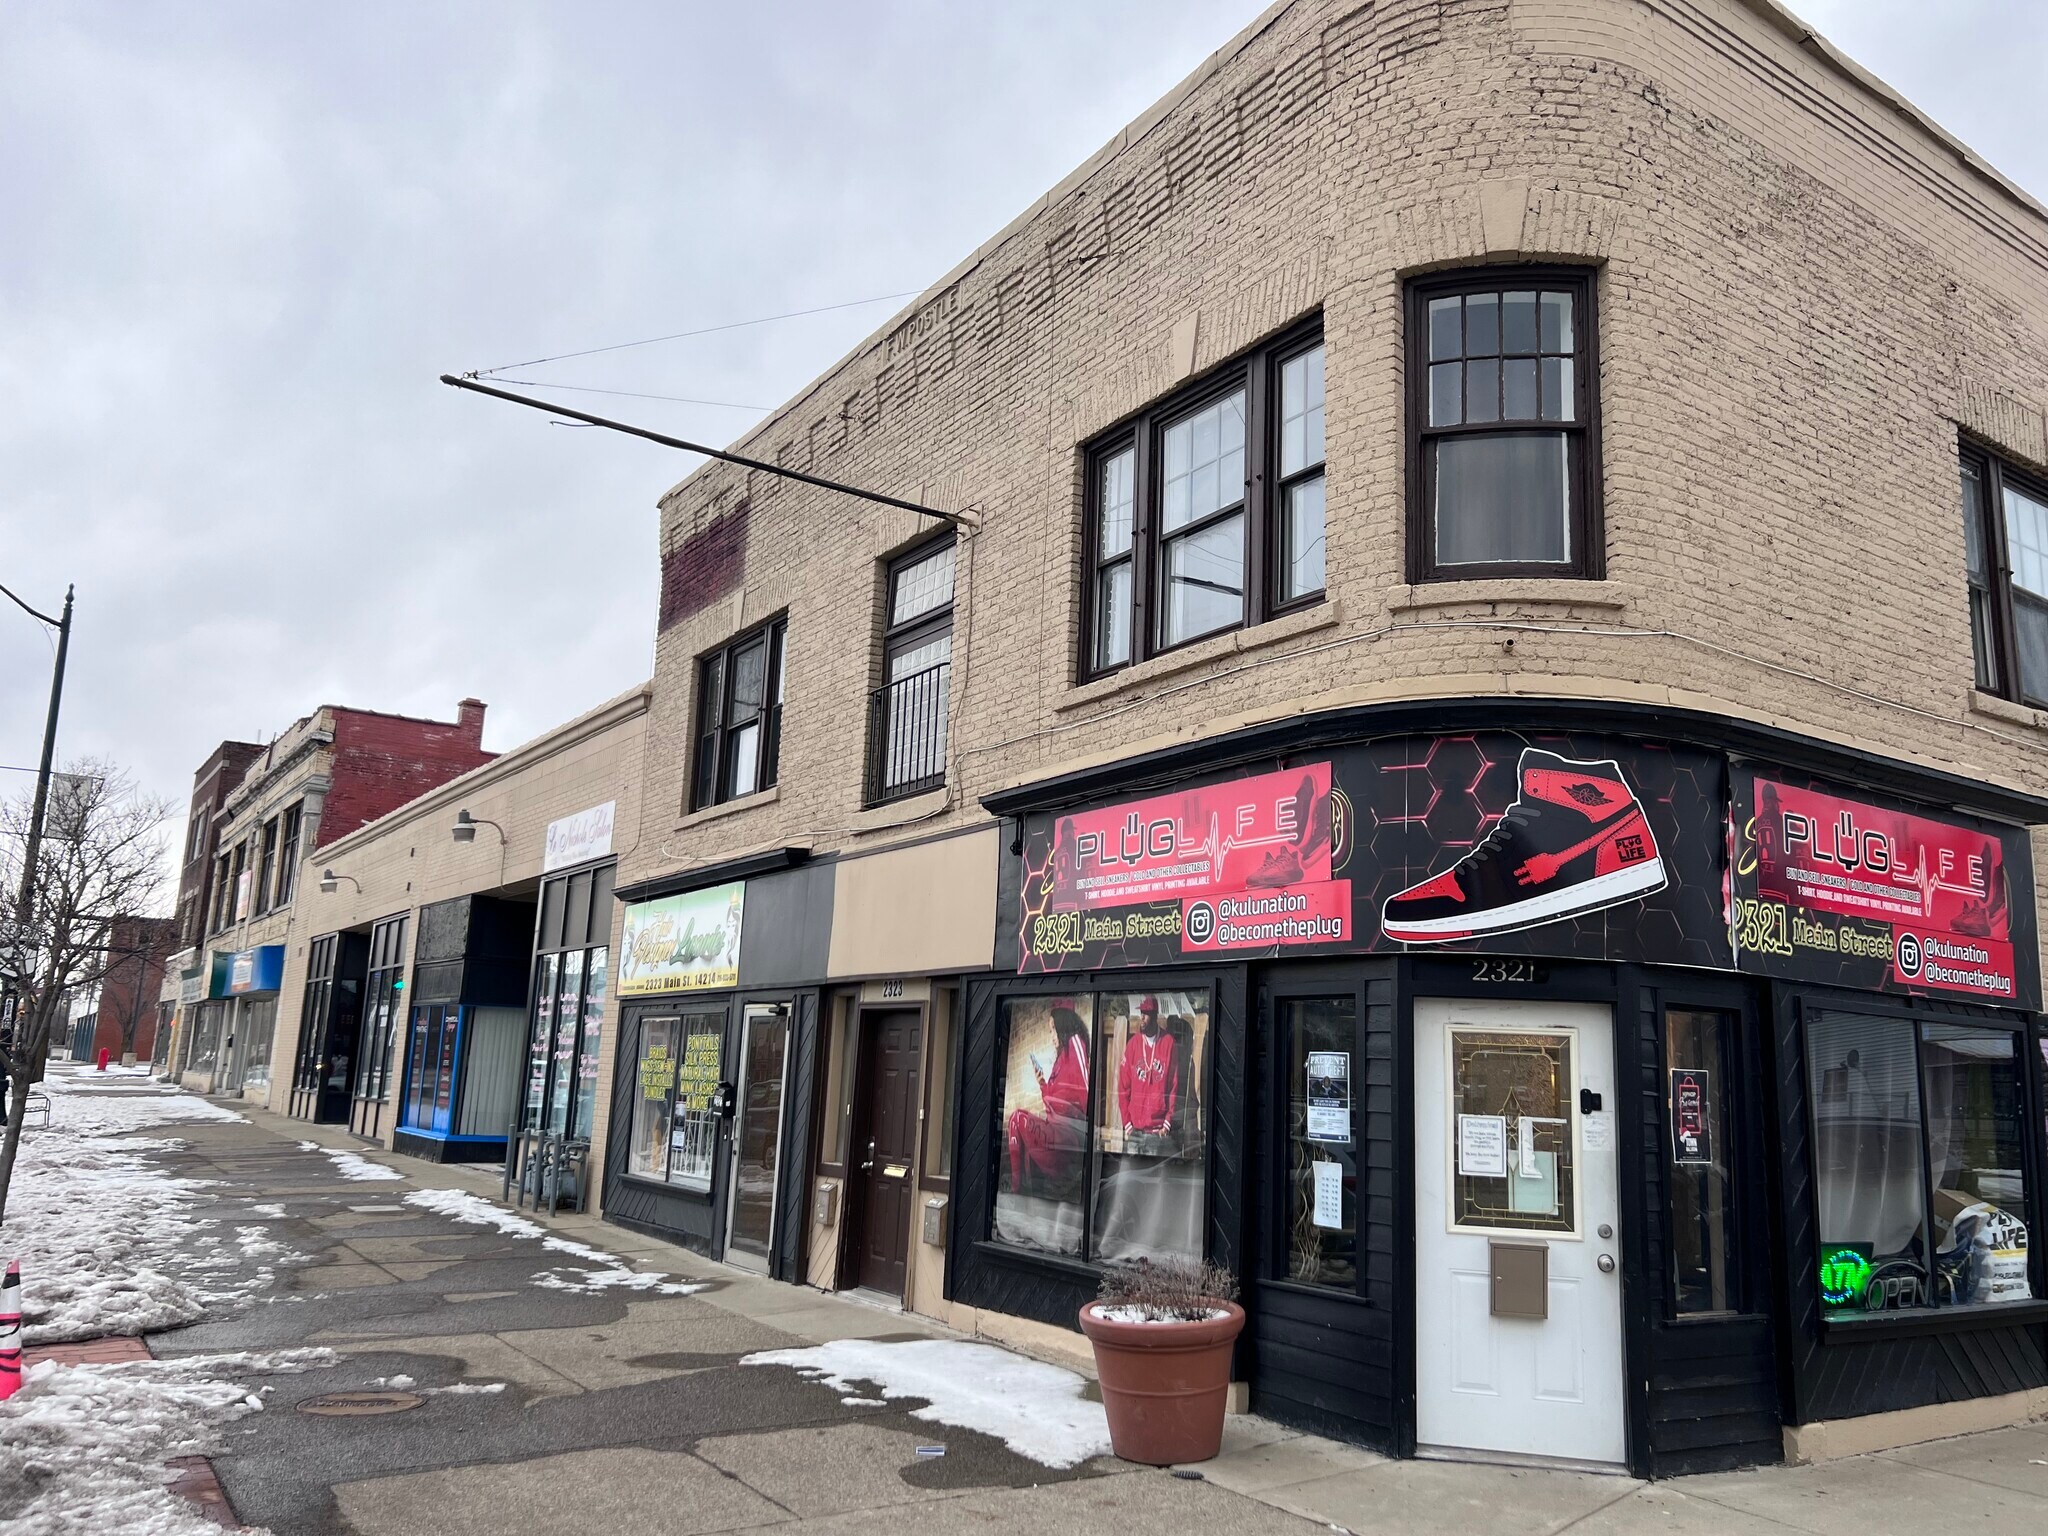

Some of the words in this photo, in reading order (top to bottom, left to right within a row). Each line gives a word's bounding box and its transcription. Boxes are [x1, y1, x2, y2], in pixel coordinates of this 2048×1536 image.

[908, 288, 958, 345] POSTLE
[1076, 812, 1175, 870] PLUG
[1615, 837, 1642, 849] PLUG
[1782, 810, 1889, 874] PLUG
[1618, 846, 1645, 860] LIFE
[1105, 872, 1129, 885] SNEAKERS
[1157, 866, 1172, 878] OTHER
[1173, 861, 1210, 875] COLLECTABLES
[1164, 879, 1185, 890] PRINTING
[1186, 875, 1210, 887] AVAILABLE
[1821, 873, 1846, 889] SNEAKERS
[1863, 881, 1873, 894] AND
[1873, 883, 1889, 897] OTHER
[1219, 891, 1306, 921] @kulunation
[1034, 911, 1083, 955] 2321
[1085, 916, 1122, 941] Main
[1126, 909, 1182, 938] Street
[1218, 914, 1342, 945] @becometheplug
[1793, 916, 1837, 951] Main
[1840, 926, 1893, 960] Street
[1924, 938, 1989, 964] @kulunation
[645, 979, 662, 990] 2323
[663, 977, 680, 989] Main
[682, 975, 692, 987] St.
[695, 972, 716, 986] 14214
[1472, 959, 1534, 982] 2321
[1925, 962, 2011, 994] @becometheplug
[883, 979, 903, 998] 2323
[687, 1034, 719, 1051] PONYTAILS
[685, 1050, 698, 1066] SILK
[699, 1050, 718, 1066] PRESS
[1310, 1056, 1345, 1065] PREVENT
[680, 1065, 705, 1081] NATURAL
[706, 1066, 720, 1081] HAIR
[1310, 1065, 1325, 1076] AUTO
[1326, 1065, 1345, 1076] THEFT
[695, 1080, 718, 1097] LASHES
[691, 1095, 708, 1112] MORE
